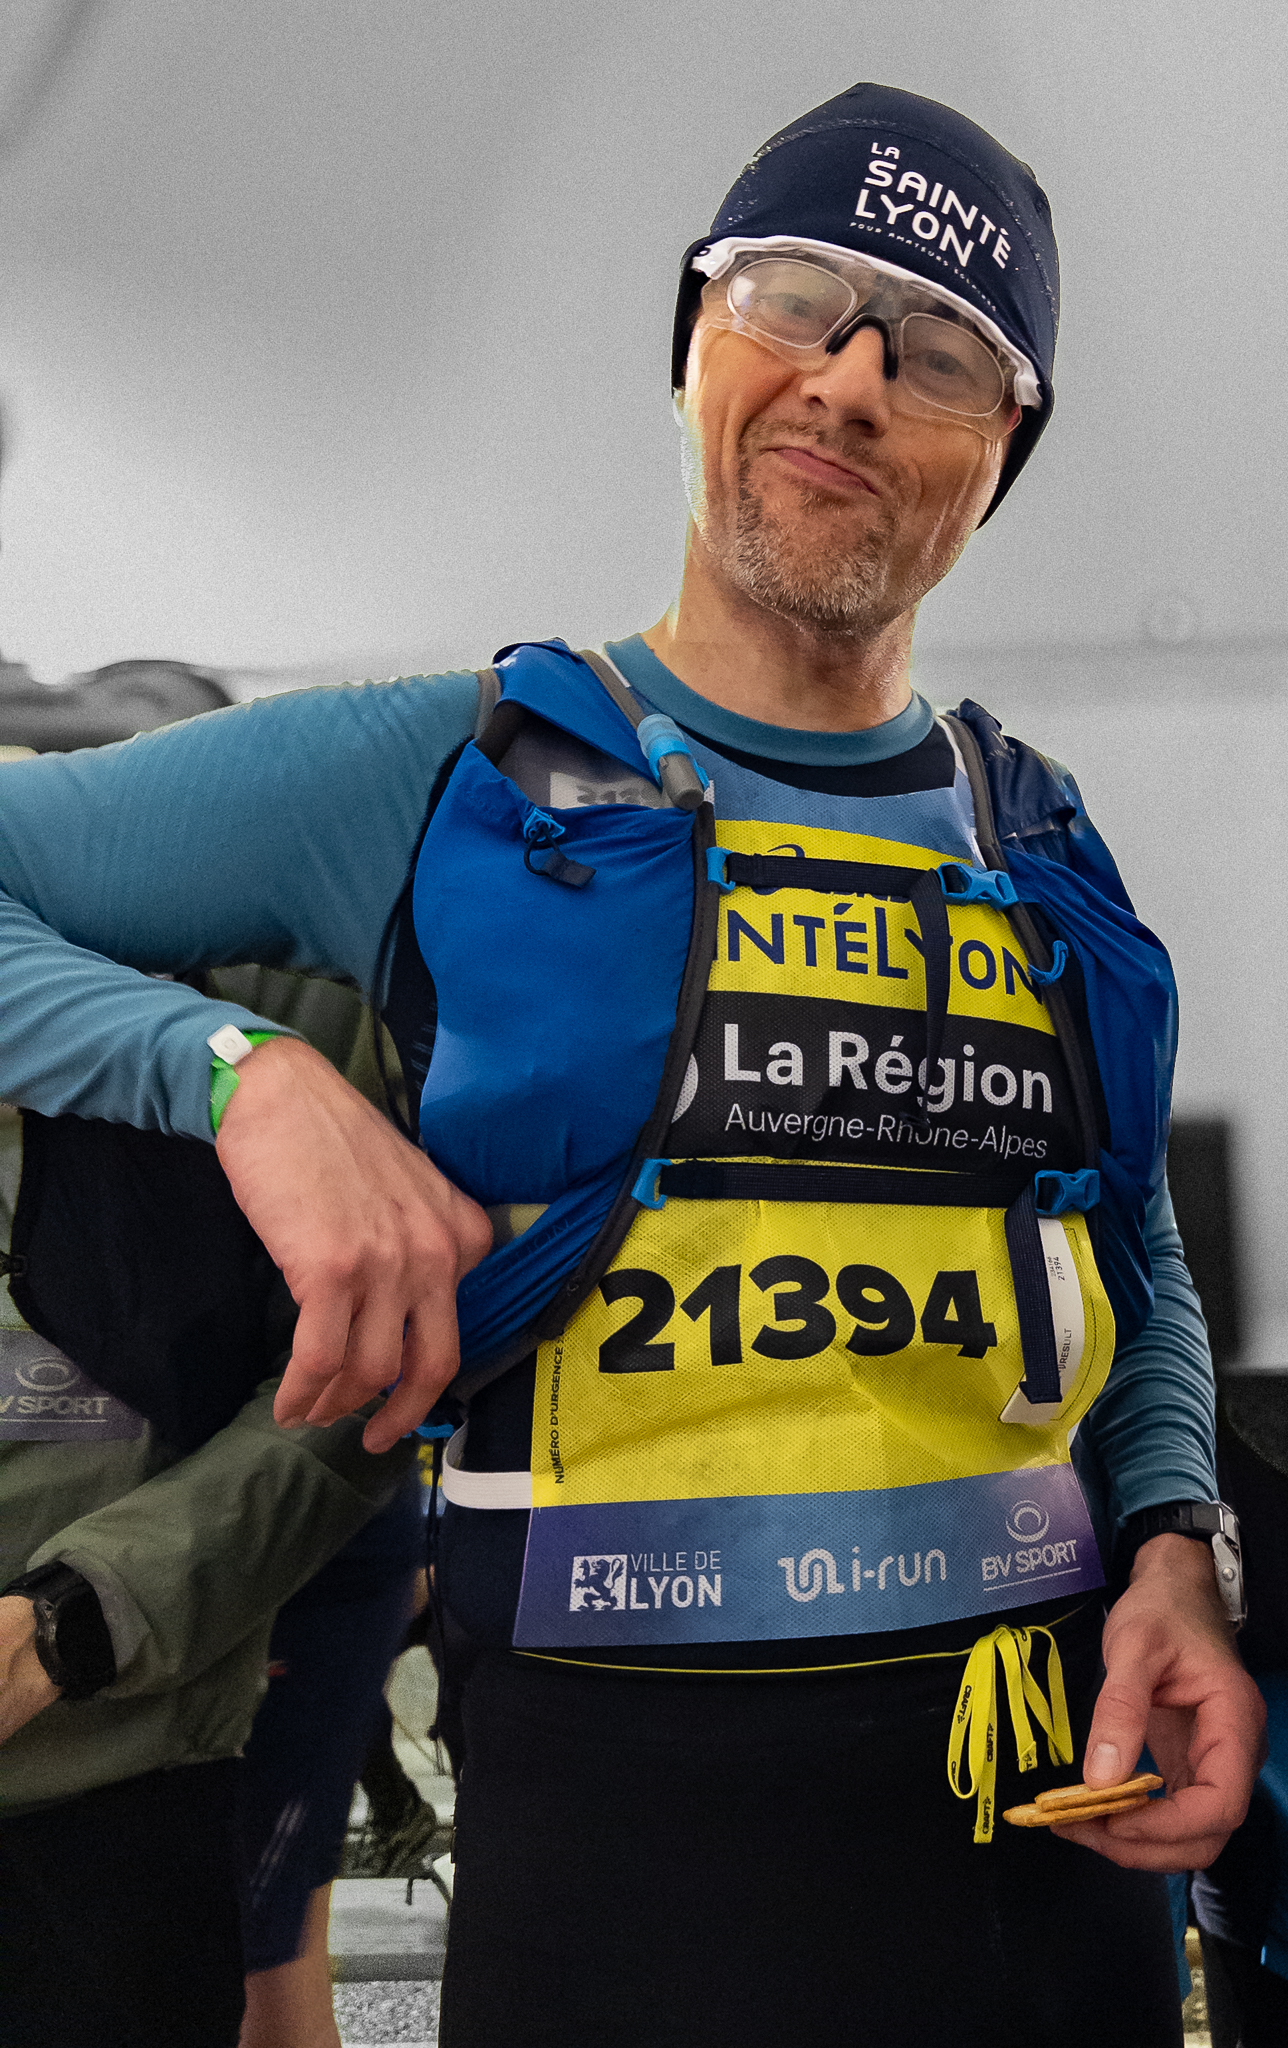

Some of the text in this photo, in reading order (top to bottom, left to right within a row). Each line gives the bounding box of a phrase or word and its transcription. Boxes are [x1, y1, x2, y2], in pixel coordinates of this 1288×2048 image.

[870, 142, 900, 160] LA
[849, 221, 882, 233] POUR
[855, 188, 975, 267] LYON
[864, 159, 1011, 269] SAINTÉ
[723, 1022, 1053, 1113] La Région
[1053, 1256, 1065, 1281] 21394
[598, 1254, 998, 1374] 21394
[17, 1395, 111, 1414] SPORT
[549, 1430, 565, 1484] NUMÉRO
[631, 1550, 721, 1572] VILLE DE
[852, 1545, 947, 1592] i-run
[981, 1539, 1077, 1581] BV SPORT
[629, 1574, 722, 1610] LYON
[959, 1685, 972, 1715] CRAFT
[986, 1732, 994, 1763] CRAFT
